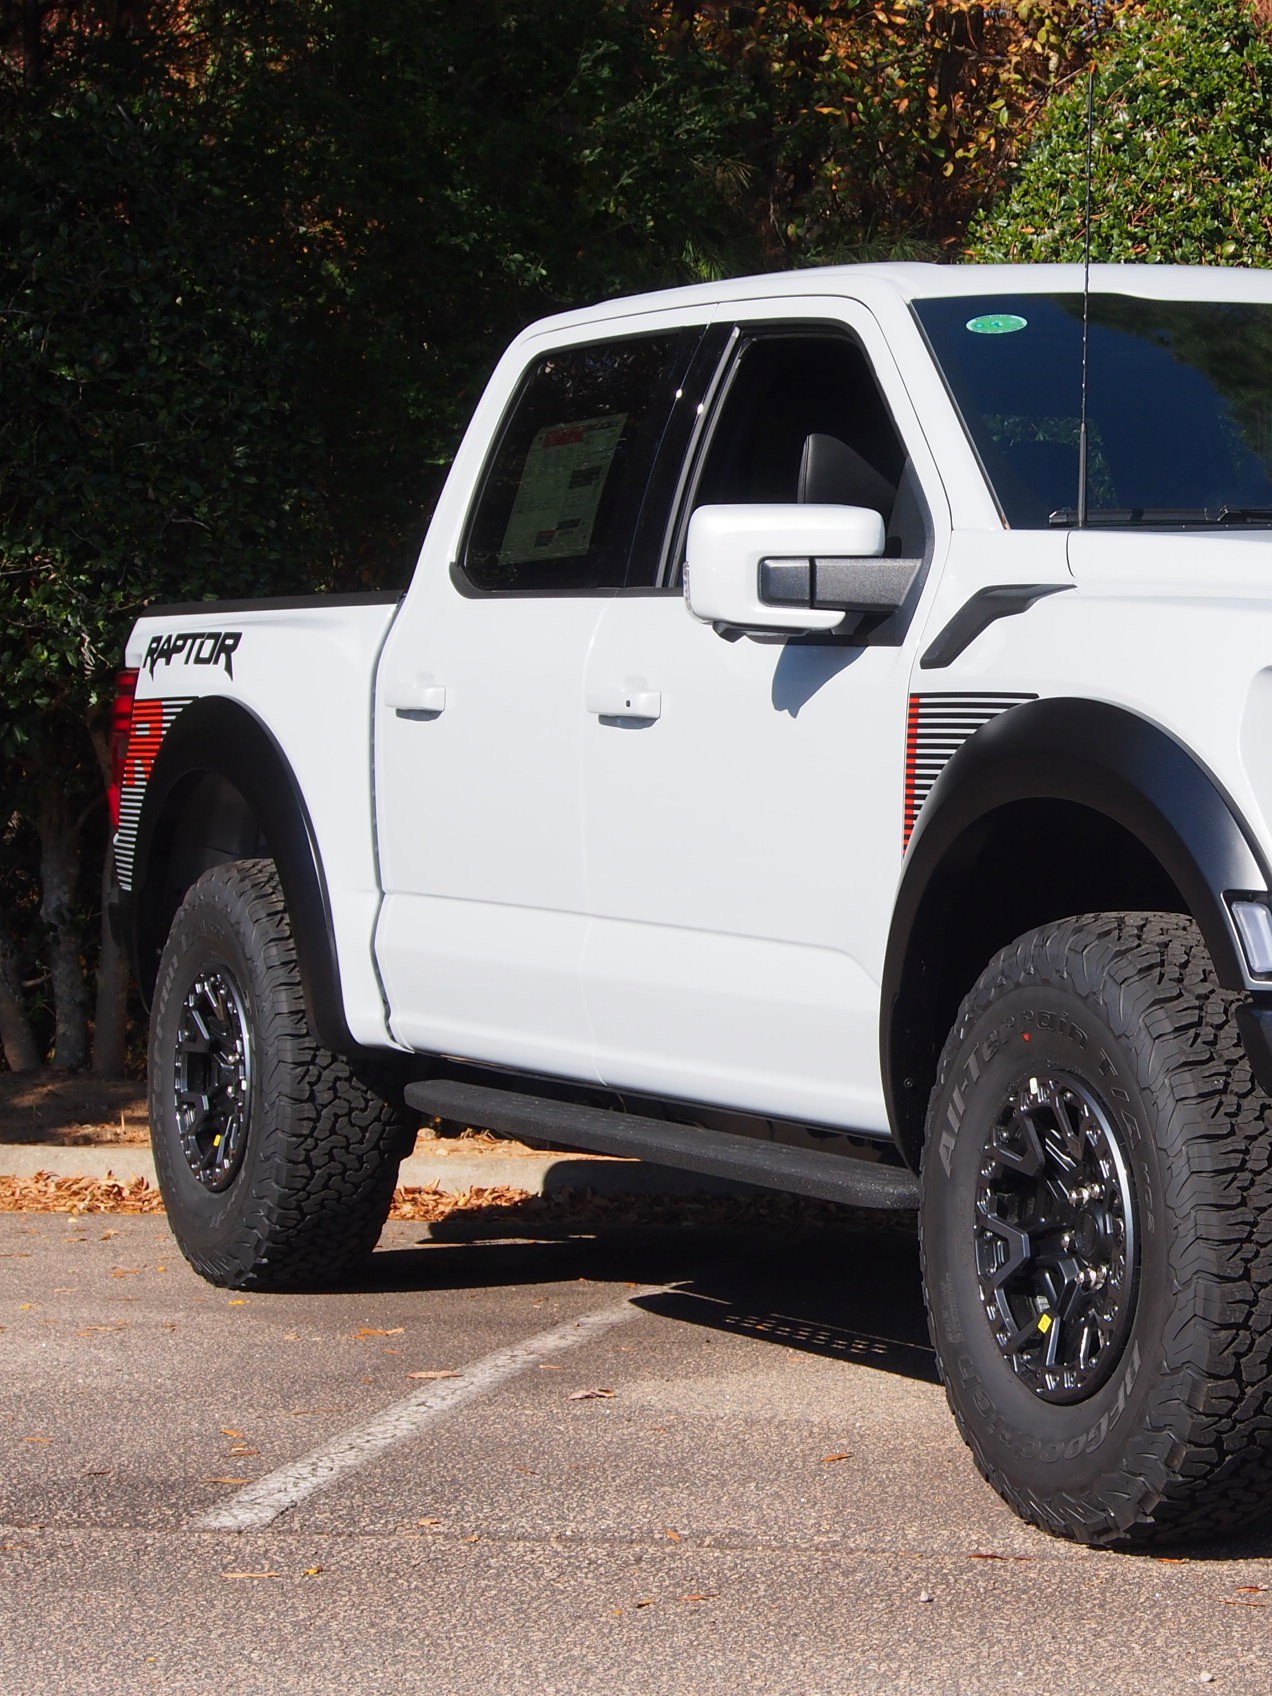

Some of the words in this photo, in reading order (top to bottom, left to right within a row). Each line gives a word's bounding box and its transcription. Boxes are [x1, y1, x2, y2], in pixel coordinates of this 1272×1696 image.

[142, 631, 243, 682] RAPTOR
[938, 1009, 1088, 1178] All-Terrain
[957, 1339, 1142, 1463] BFGoodrich
